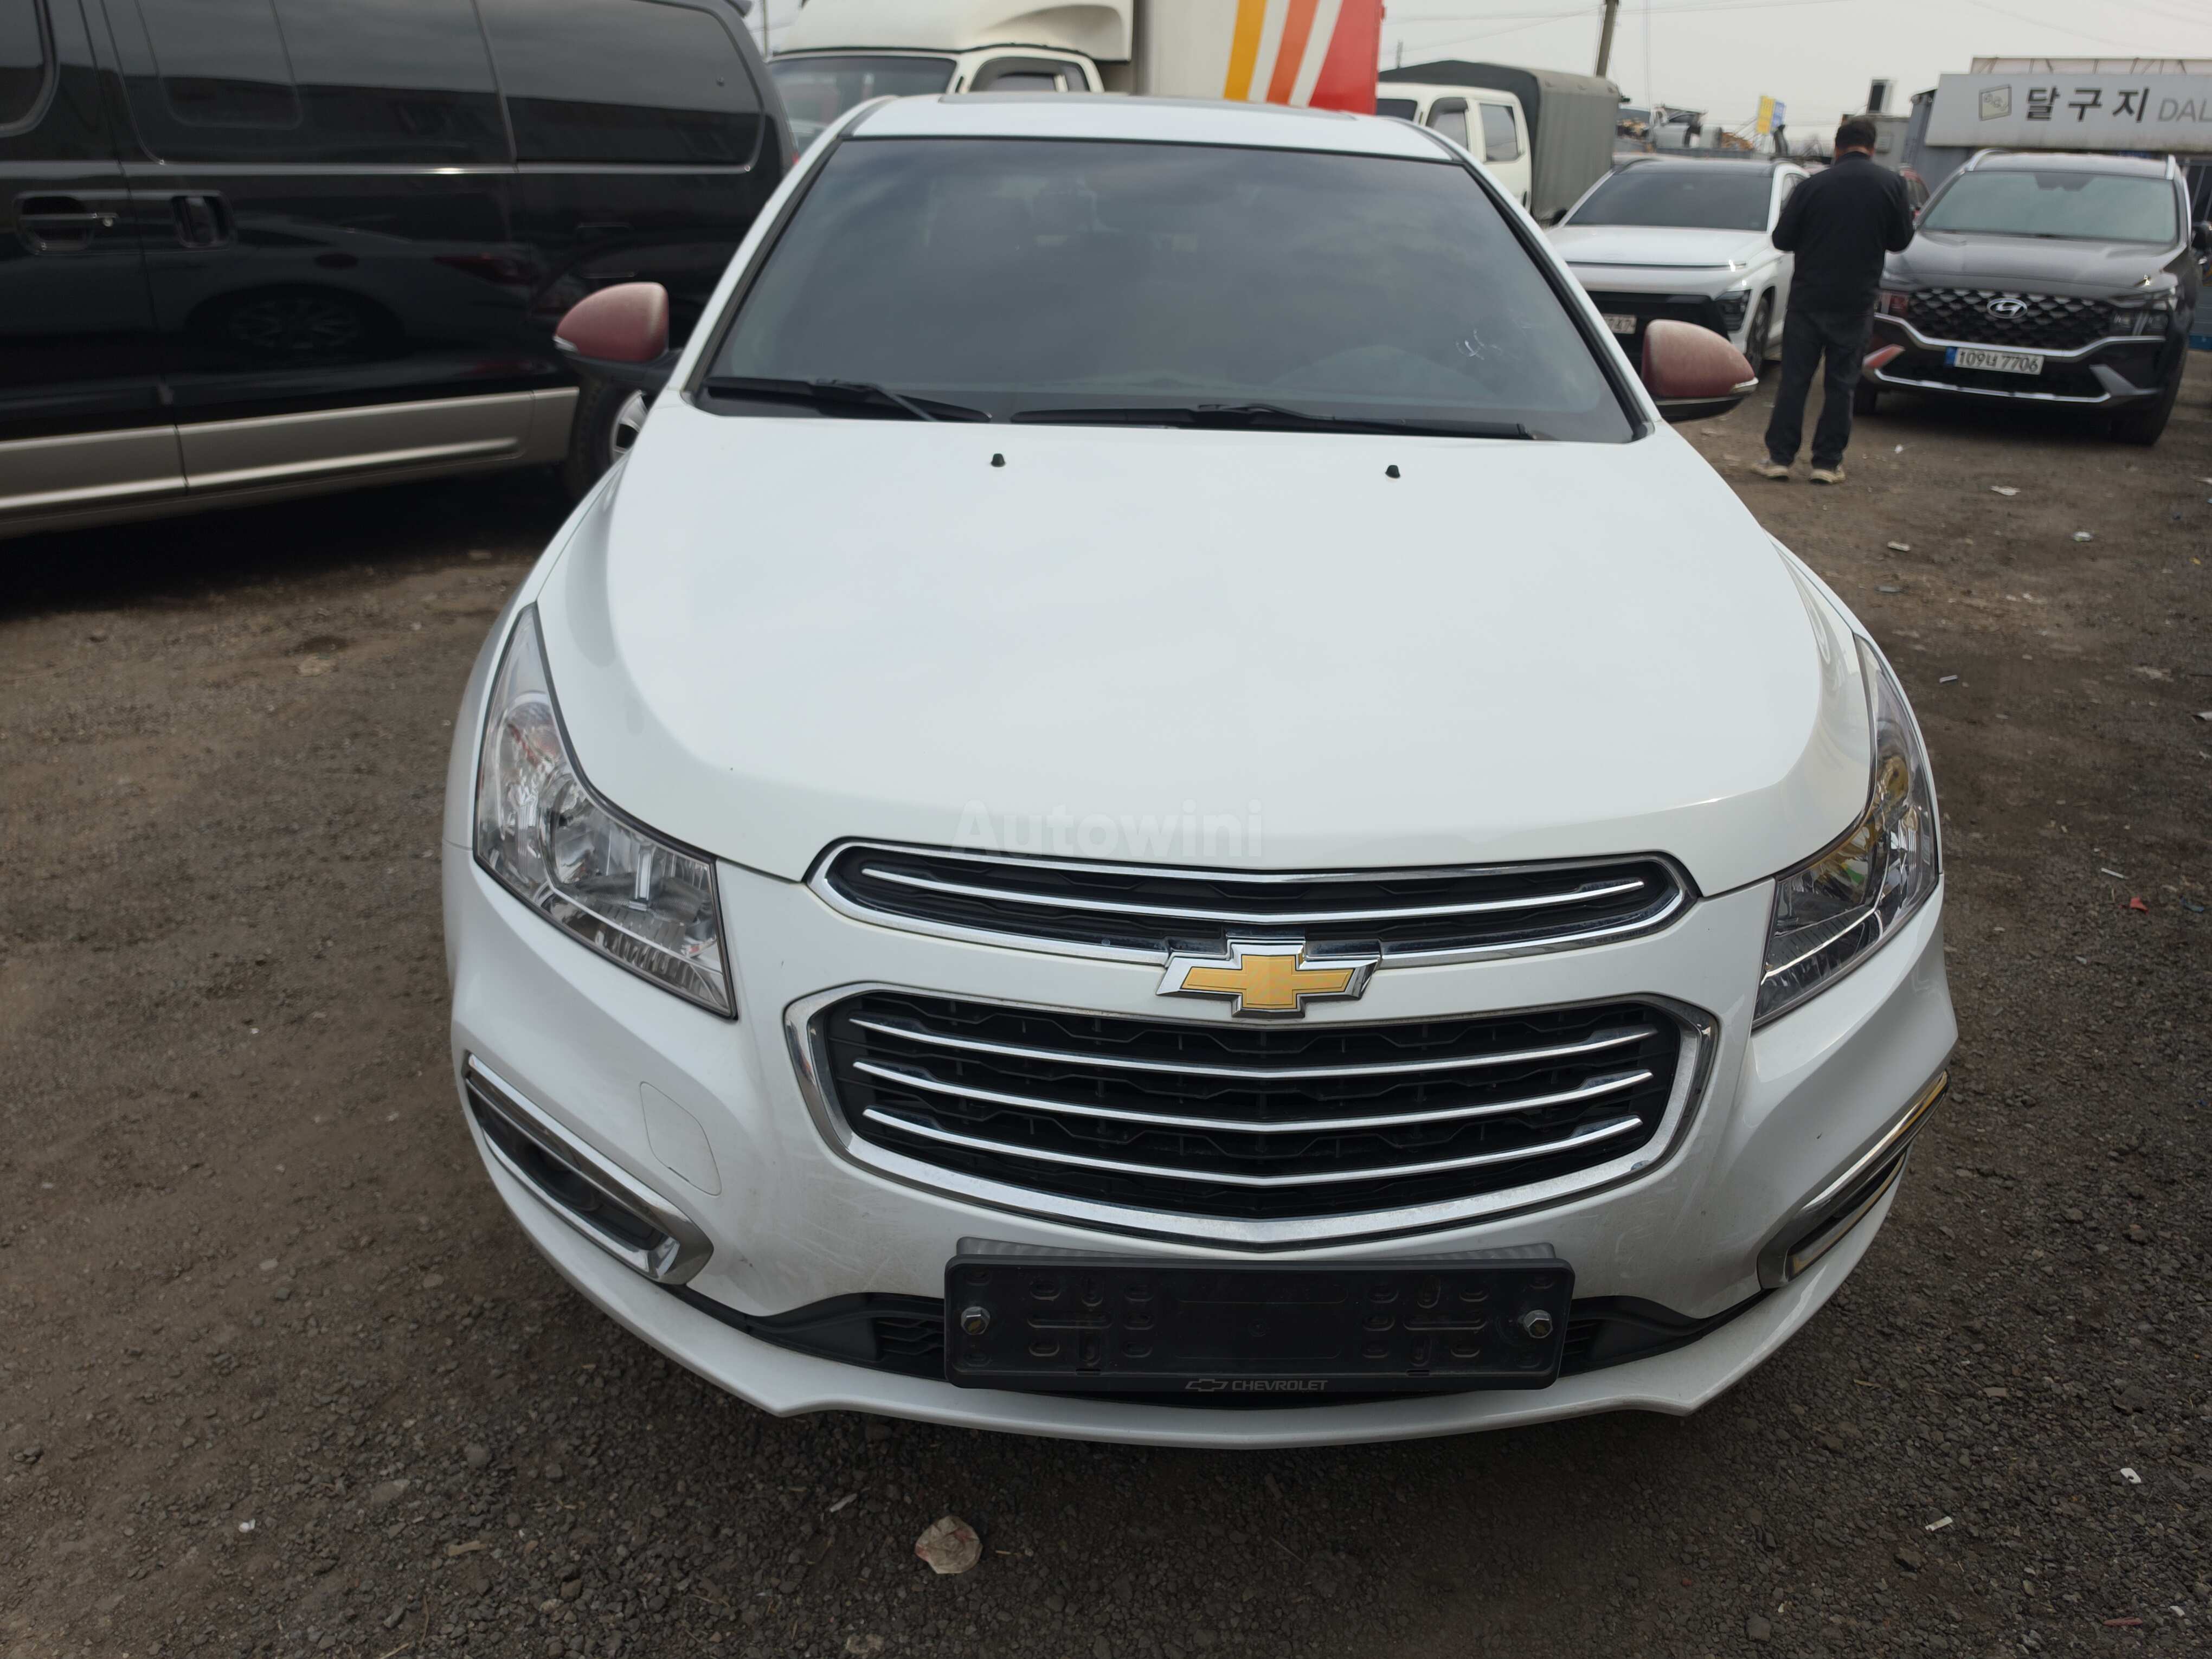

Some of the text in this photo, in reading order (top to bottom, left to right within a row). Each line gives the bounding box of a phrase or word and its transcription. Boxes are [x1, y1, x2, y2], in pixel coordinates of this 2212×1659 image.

[2027, 86, 2150, 123] 달구지
[2001, 355, 2039, 372] 7706
[1231, 1380, 1328, 1391] CHEVROLET
